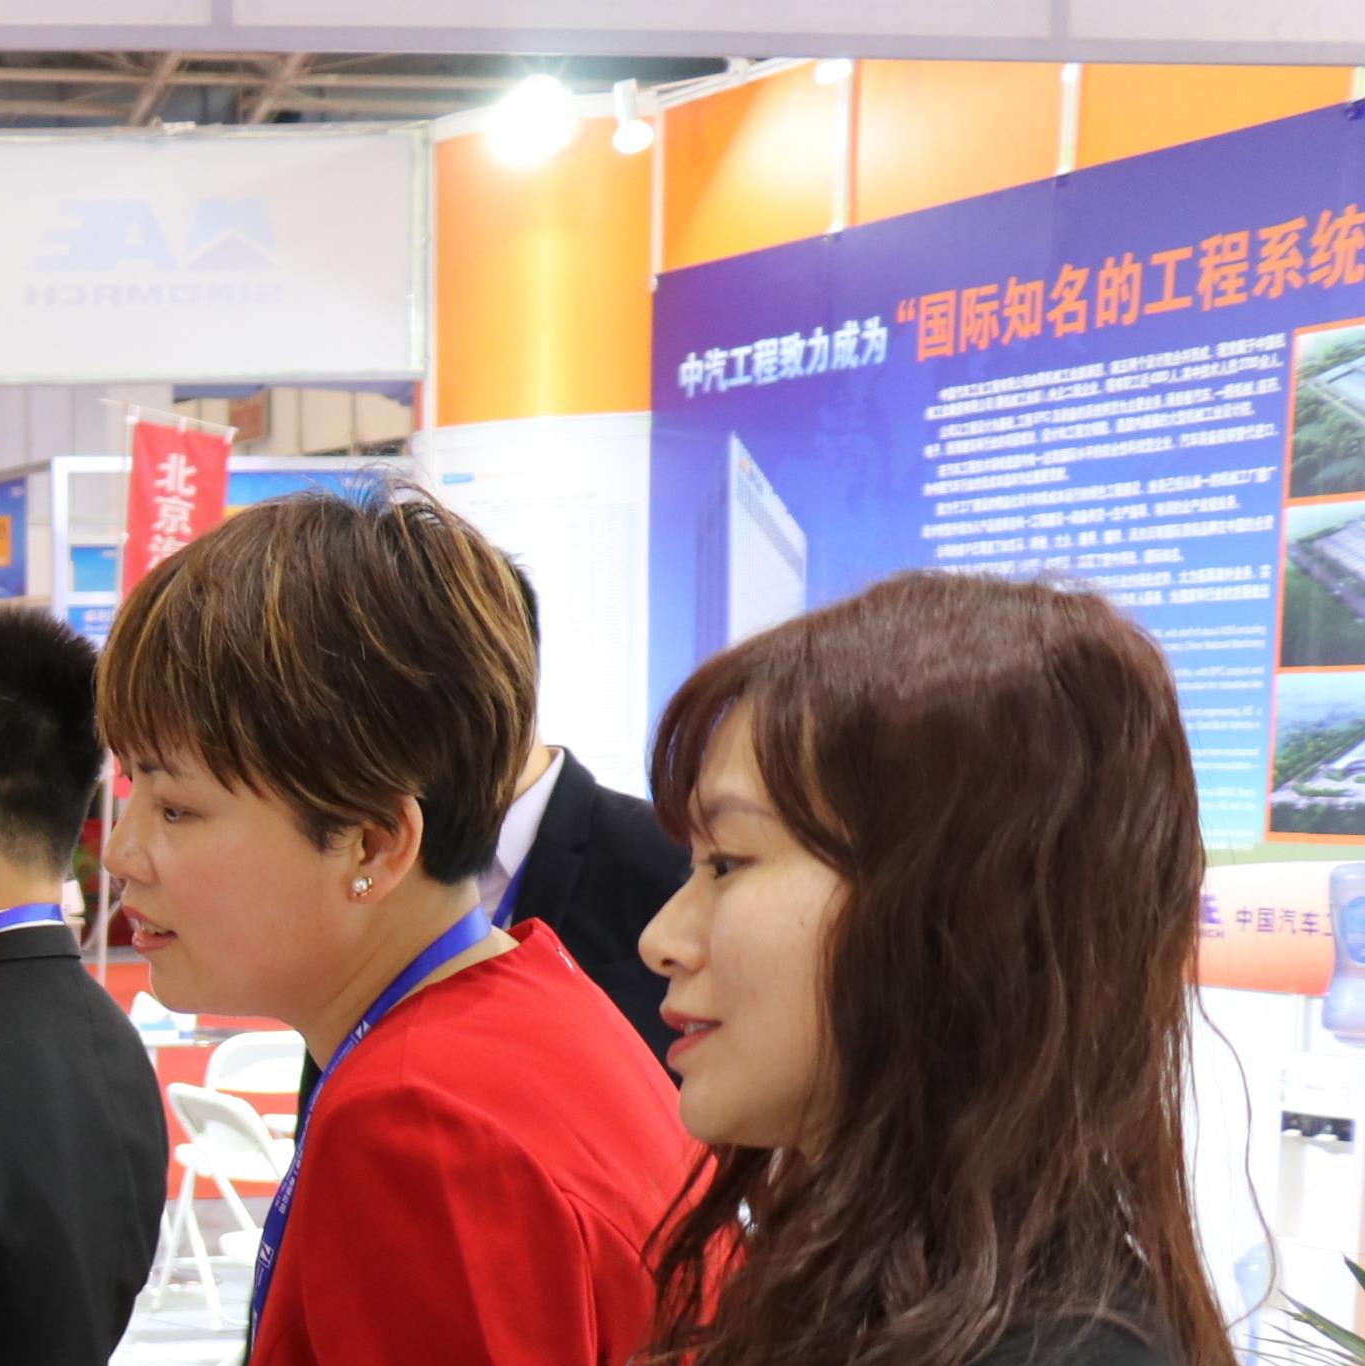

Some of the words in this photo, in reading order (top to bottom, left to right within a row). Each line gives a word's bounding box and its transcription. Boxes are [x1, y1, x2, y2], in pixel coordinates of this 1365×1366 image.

[678, 314, 889, 400] 中汽工程致力成为
